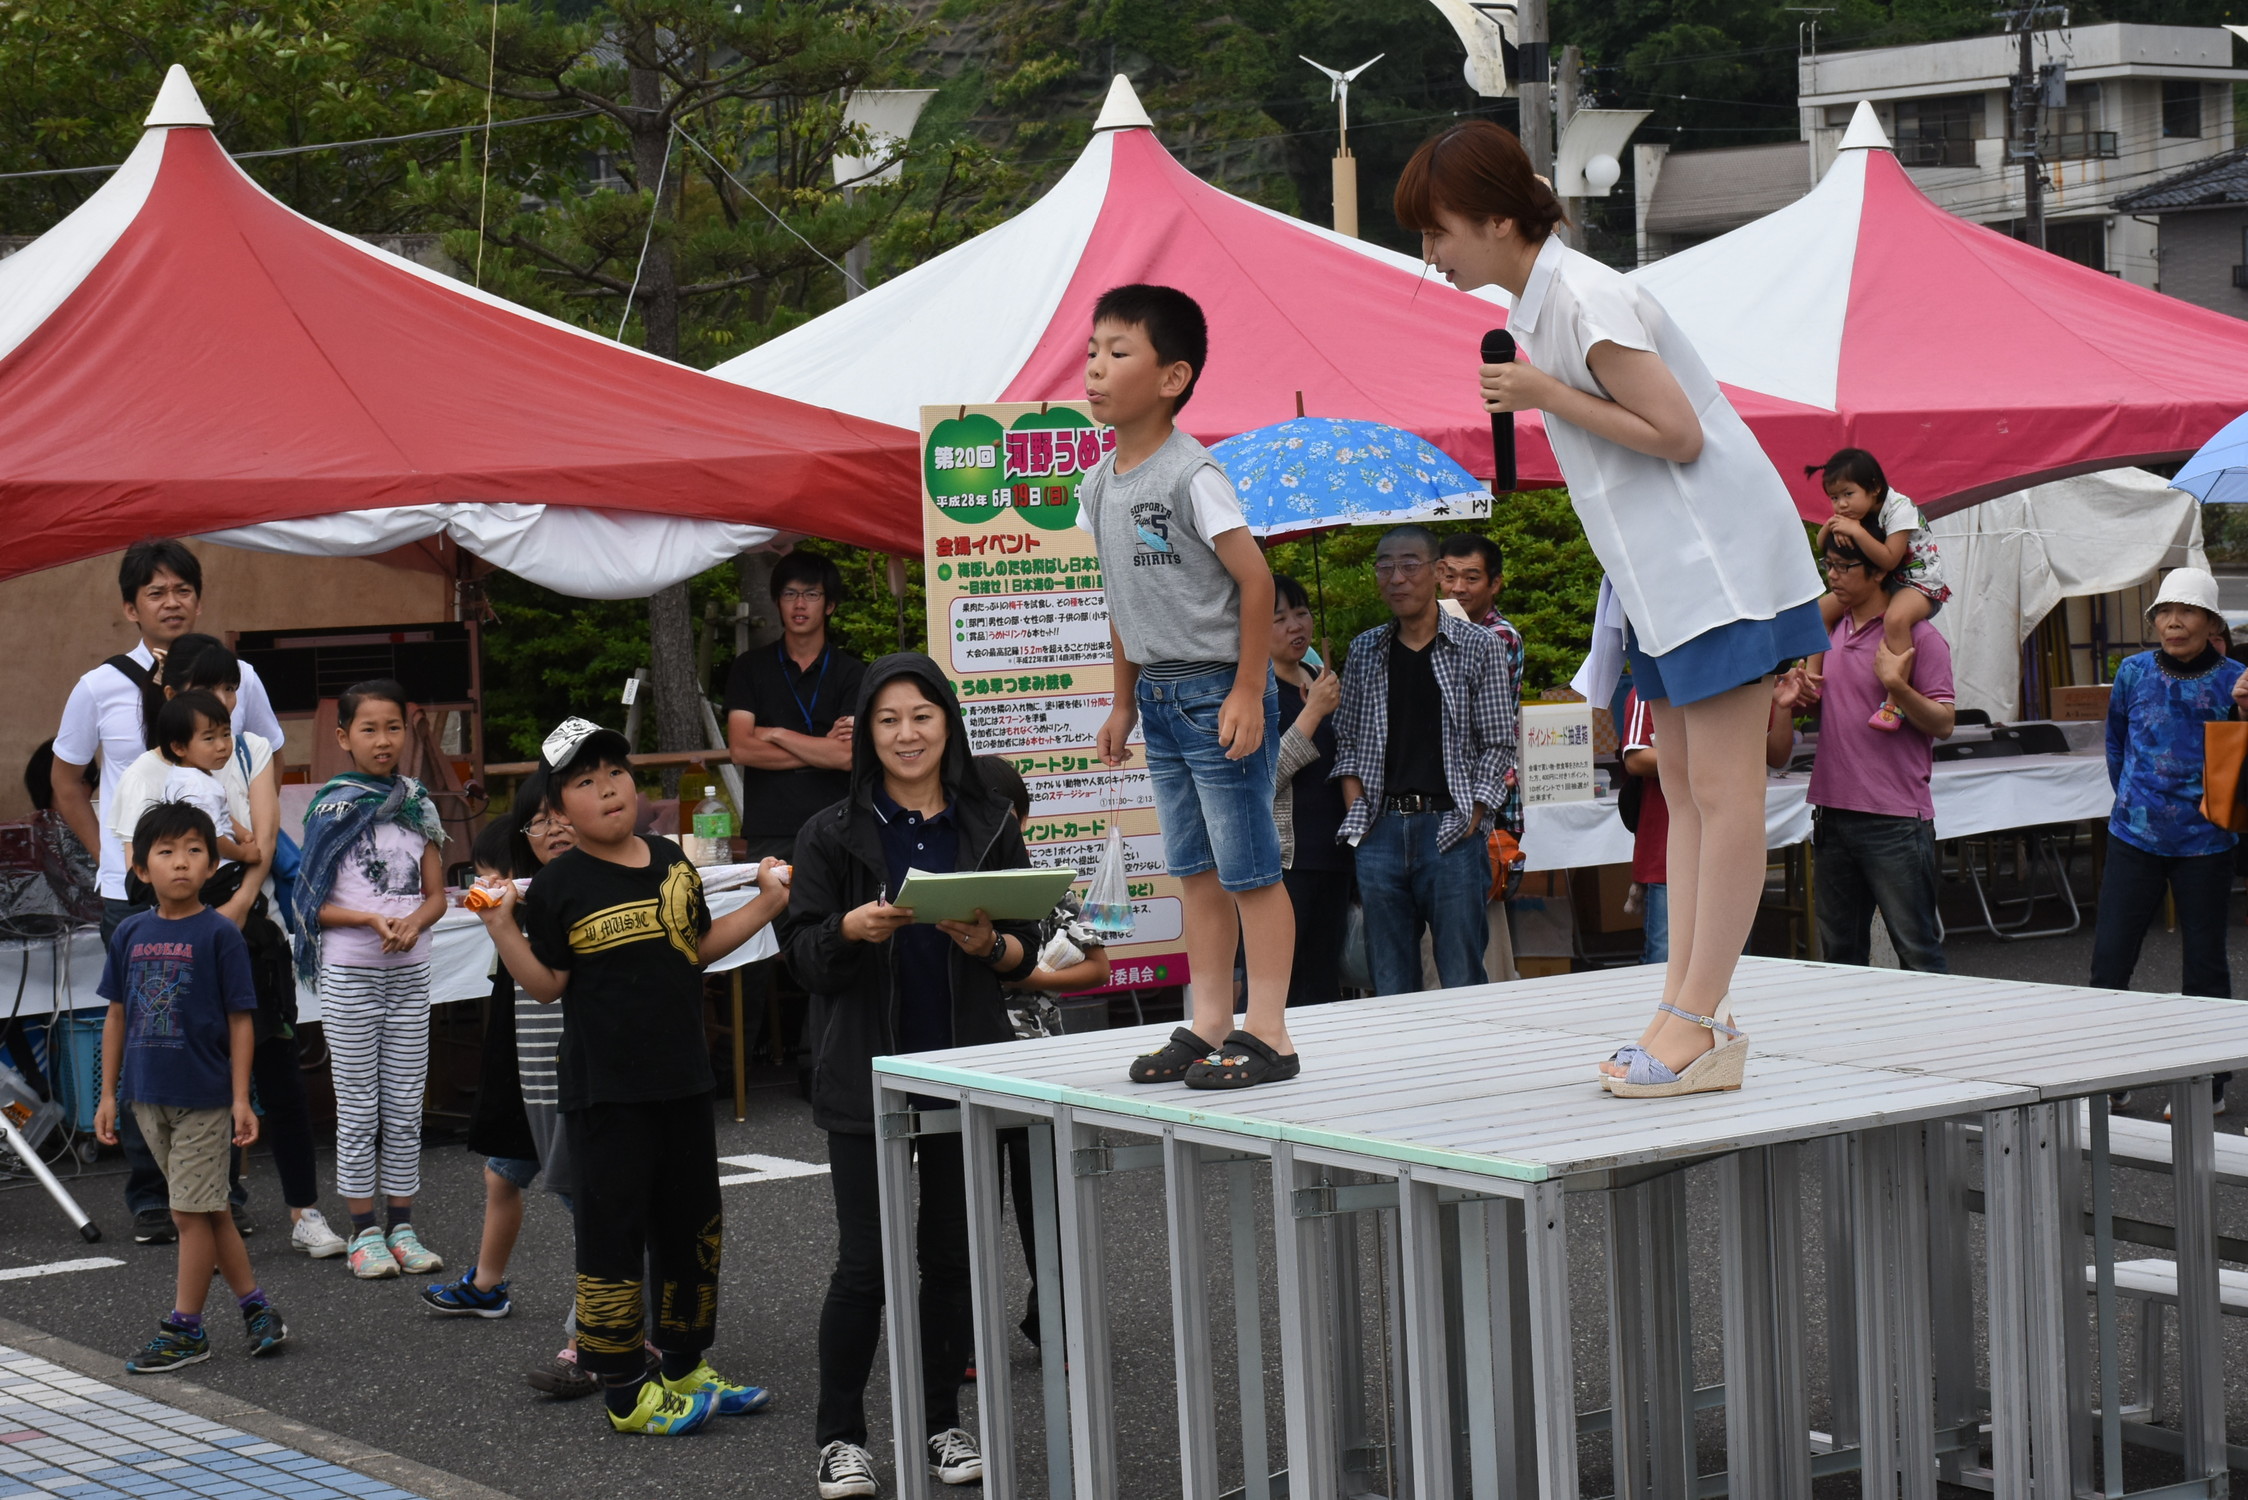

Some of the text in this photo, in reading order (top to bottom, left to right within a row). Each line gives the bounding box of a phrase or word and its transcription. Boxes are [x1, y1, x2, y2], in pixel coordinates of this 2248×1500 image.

[934, 446, 996, 470] 第20回
[936, 493, 988, 508] 平成28年
[936, 533, 1040, 557] 会場イベント
[1133, 554, 1181, 566] SPIRITS
[961, 673, 1073, 697] うめ早つまみ競争
